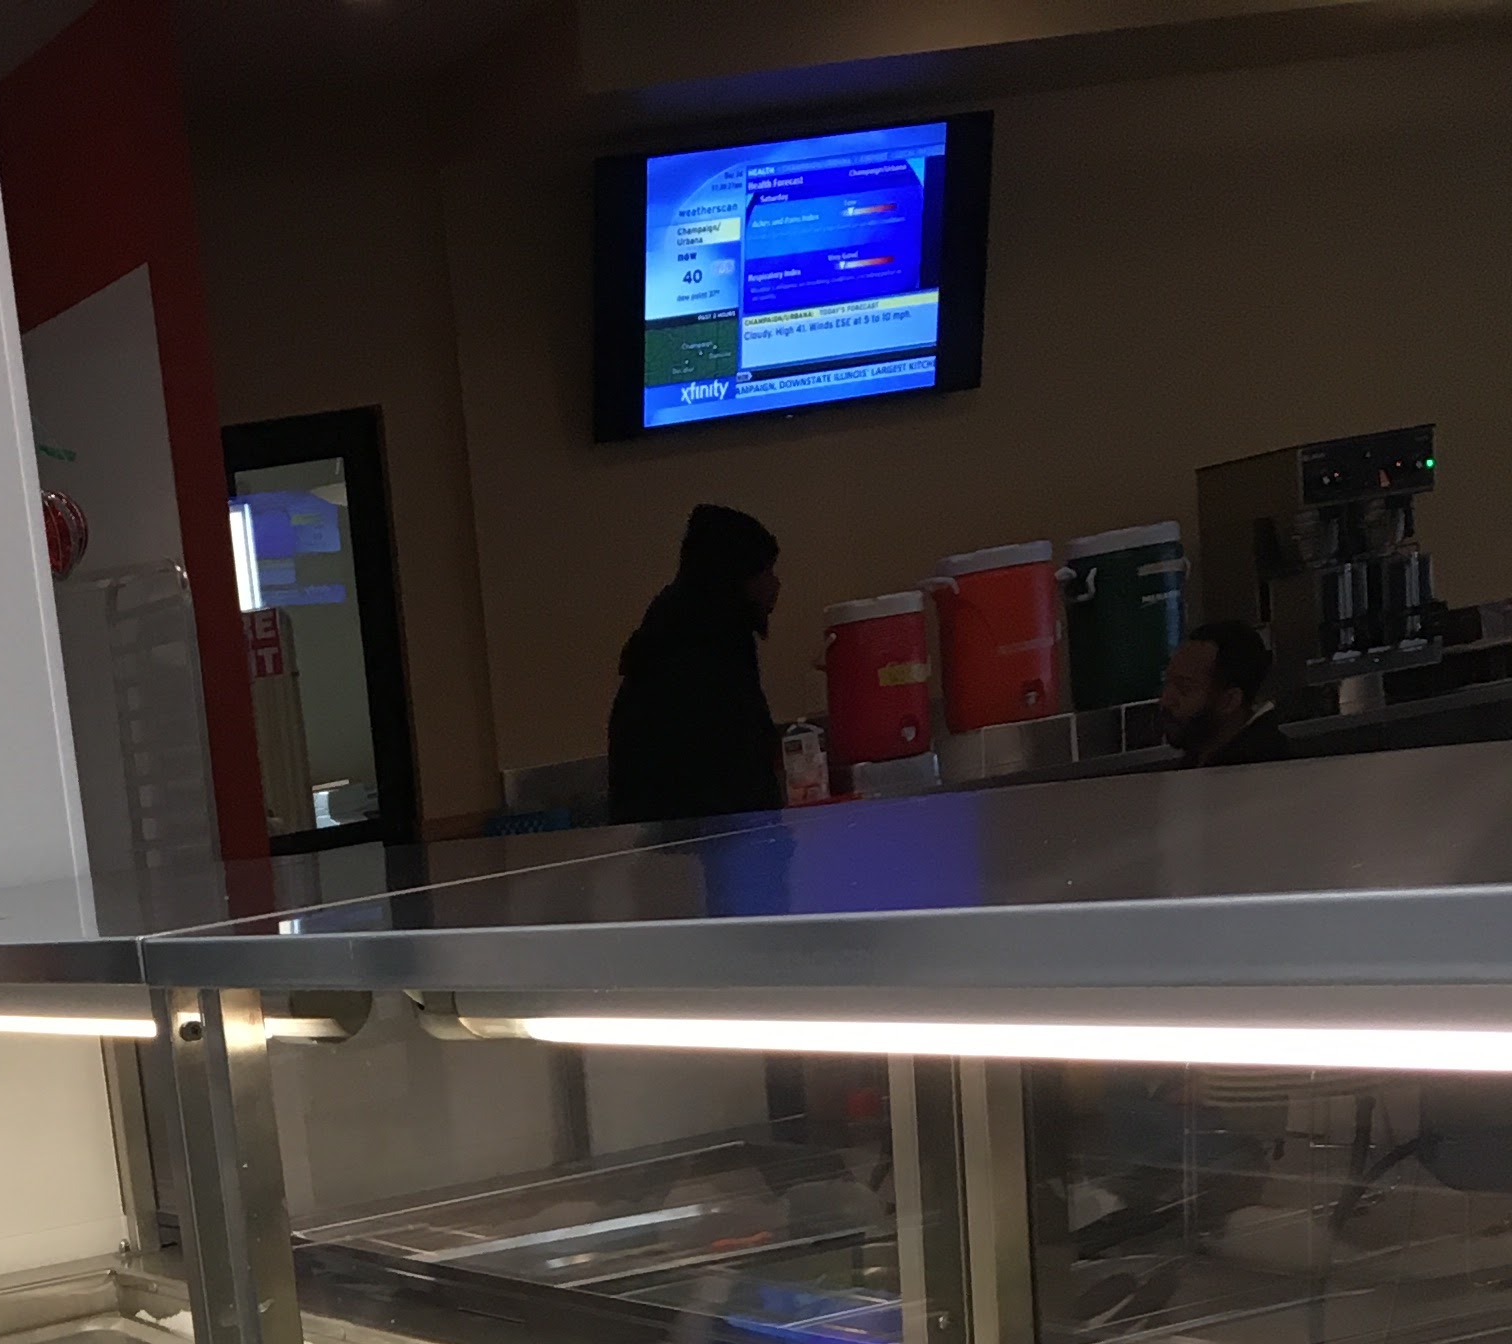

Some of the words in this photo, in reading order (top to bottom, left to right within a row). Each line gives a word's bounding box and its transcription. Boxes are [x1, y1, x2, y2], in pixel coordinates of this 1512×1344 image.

[748, 180, 773, 191] Health
[773, 176, 804, 188] Forecast
[759, 193, 789, 203] Saturday
[678, 202, 738, 218] weatherscan
[677, 222, 722, 237] Champaign/
[677, 236, 704, 247] Urbana
[677, 252, 698, 262] now
[682, 269, 703, 284] 40
[846, 301, 880, 313] FORECAST
[775, 326, 795, 338] High
[809, 320, 834, 333] Winds
[835, 318, 851, 329] ESE
[853, 316, 862, 326] at
[872, 314, 880, 323] to
[779, 375, 832, 390] DOWNSTATE
[871, 362, 907, 377] LARGEST
[680, 379, 729, 405] xfinity
